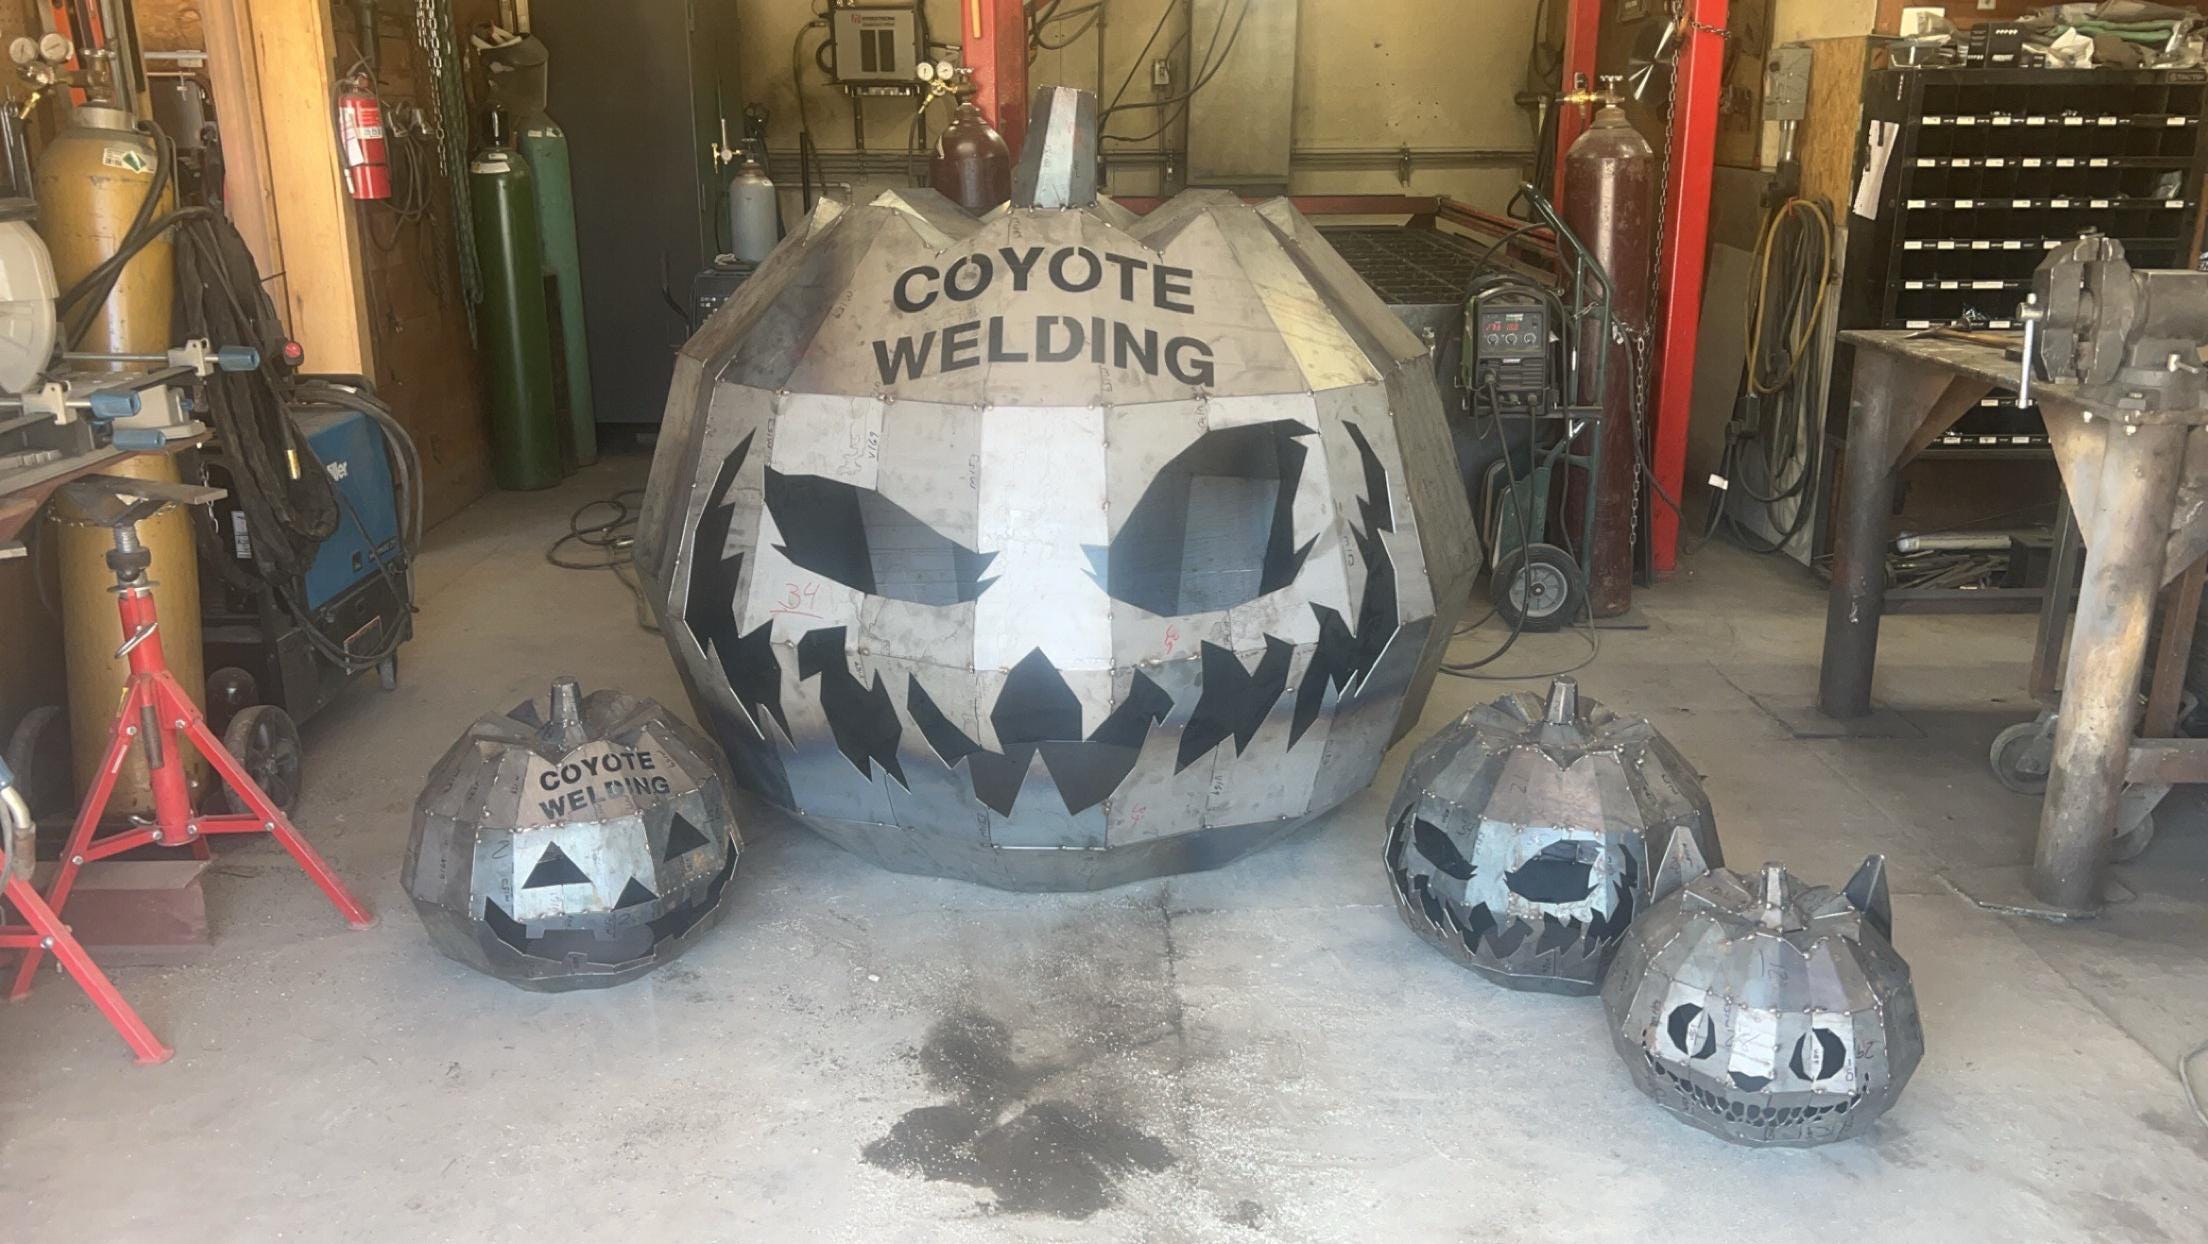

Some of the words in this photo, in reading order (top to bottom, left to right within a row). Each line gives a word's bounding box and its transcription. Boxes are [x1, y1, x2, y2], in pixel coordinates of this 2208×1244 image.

[893, 246, 1195, 314] COYOTE
[872, 316, 1215, 387] WELDING
[777, 582, 821, 611] 34
[539, 752, 656, 791] COYOTE
[538, 775, 671, 820] WELDING
